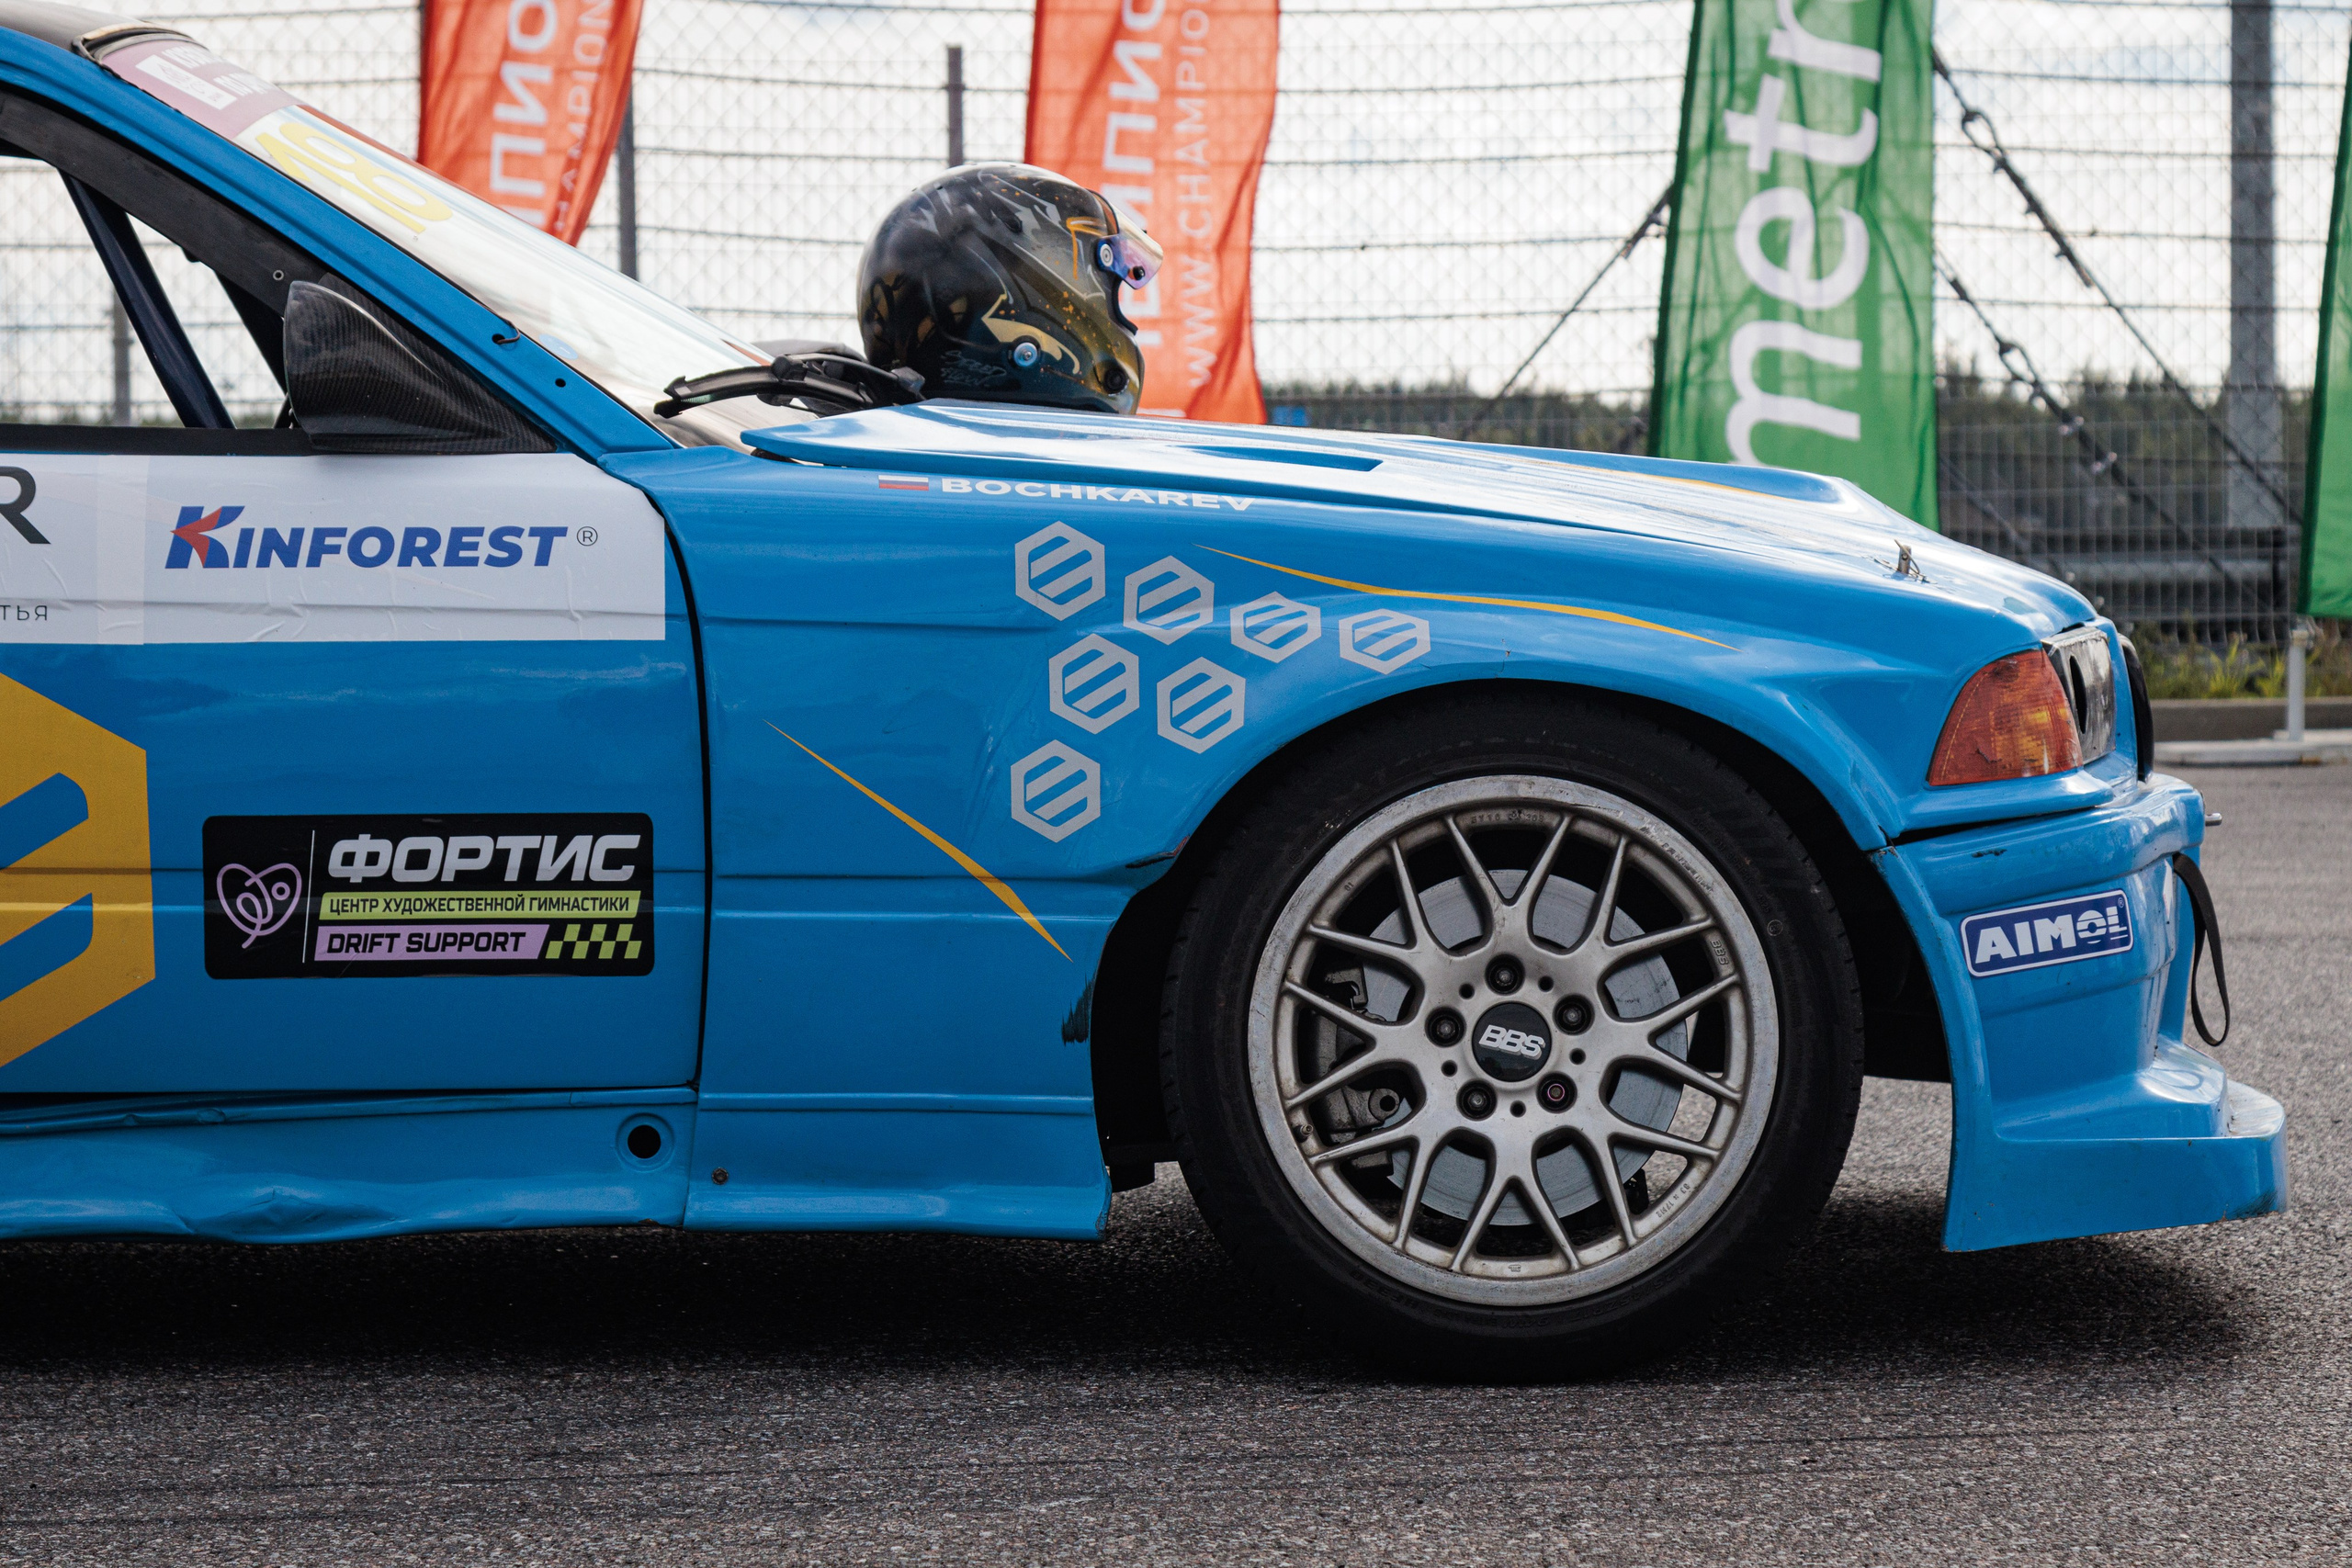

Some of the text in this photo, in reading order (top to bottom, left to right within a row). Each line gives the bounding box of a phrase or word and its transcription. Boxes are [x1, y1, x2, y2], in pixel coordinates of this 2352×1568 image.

[490, 0, 557, 225] ПИО
[1100, 0, 1166, 347] ЕМПИО
[1173, 0, 1217, 388] WWW.CHAMPIO
[942, 478, 1256, 512] BOCHKAREV
[165, 505, 569, 570] KINFOREST
[0, 604, 48, 621] ТЬЯ
[328, 833, 641, 883] ФОРТИС
[329, 894, 629, 915] ЦЕНТР ХУДОЖЕСТВЕННОЙ ГИМНАСТИКИ
[326, 931, 526, 953] DRIFT SUPPORT
[1710, 939, 1729, 965] BBS
[1975, 906, 2129, 964] AIMOL
[1478, 1024, 1546, 1060] BBS
